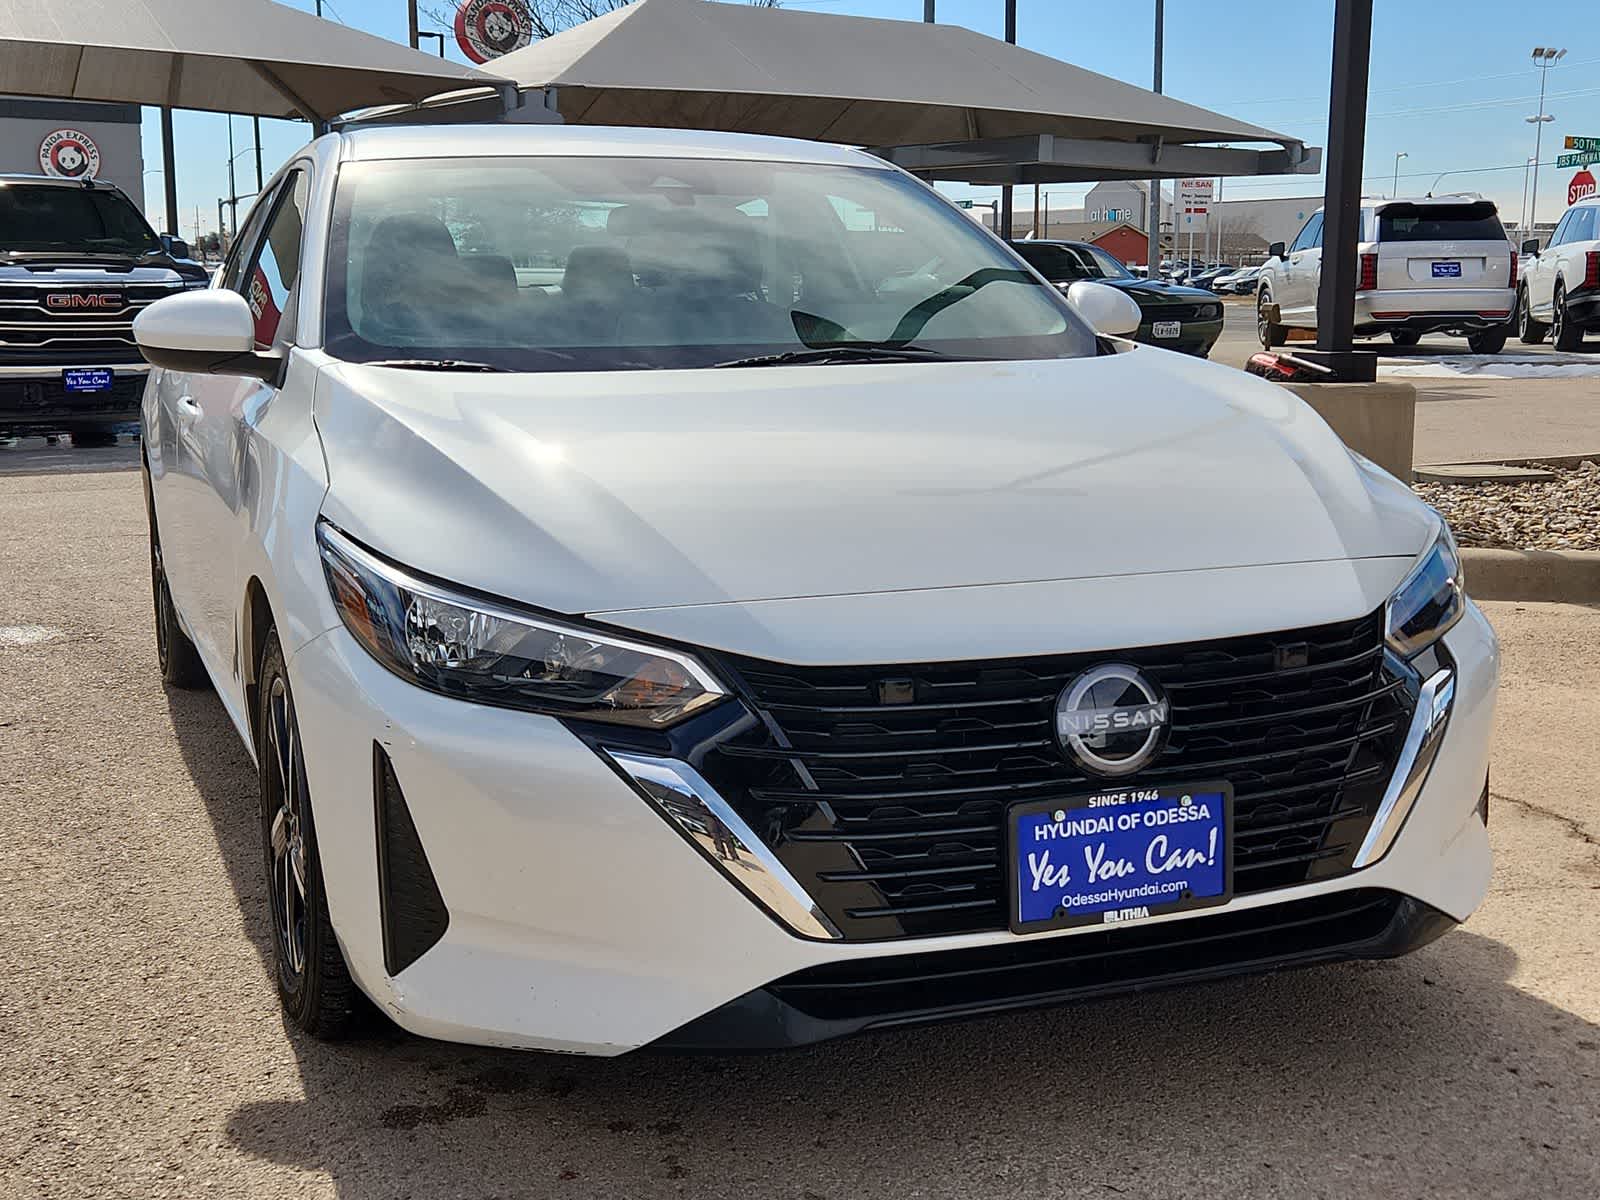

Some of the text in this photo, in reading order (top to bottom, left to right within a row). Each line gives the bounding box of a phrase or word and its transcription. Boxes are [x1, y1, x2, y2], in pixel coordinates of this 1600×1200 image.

[41, 131, 98, 160] PANDA EXPRESS
[1569, 183, 1595, 203] STOP
[47, 294, 122, 307] GMC
[66, 377, 77, 385] Yes
[78, 377, 91, 385] You
[1062, 708, 1165, 730] NISSAN
[1088, 790, 1159, 808] SINCE 1946
[1034, 804, 1211, 841] HYUNDAI OF ODESSA
[1027, 826, 1218, 891] Yes You Can!
[1061, 879, 1188, 908] OdessaHyundai.com
[1114, 906, 1149, 923] LITHIA
